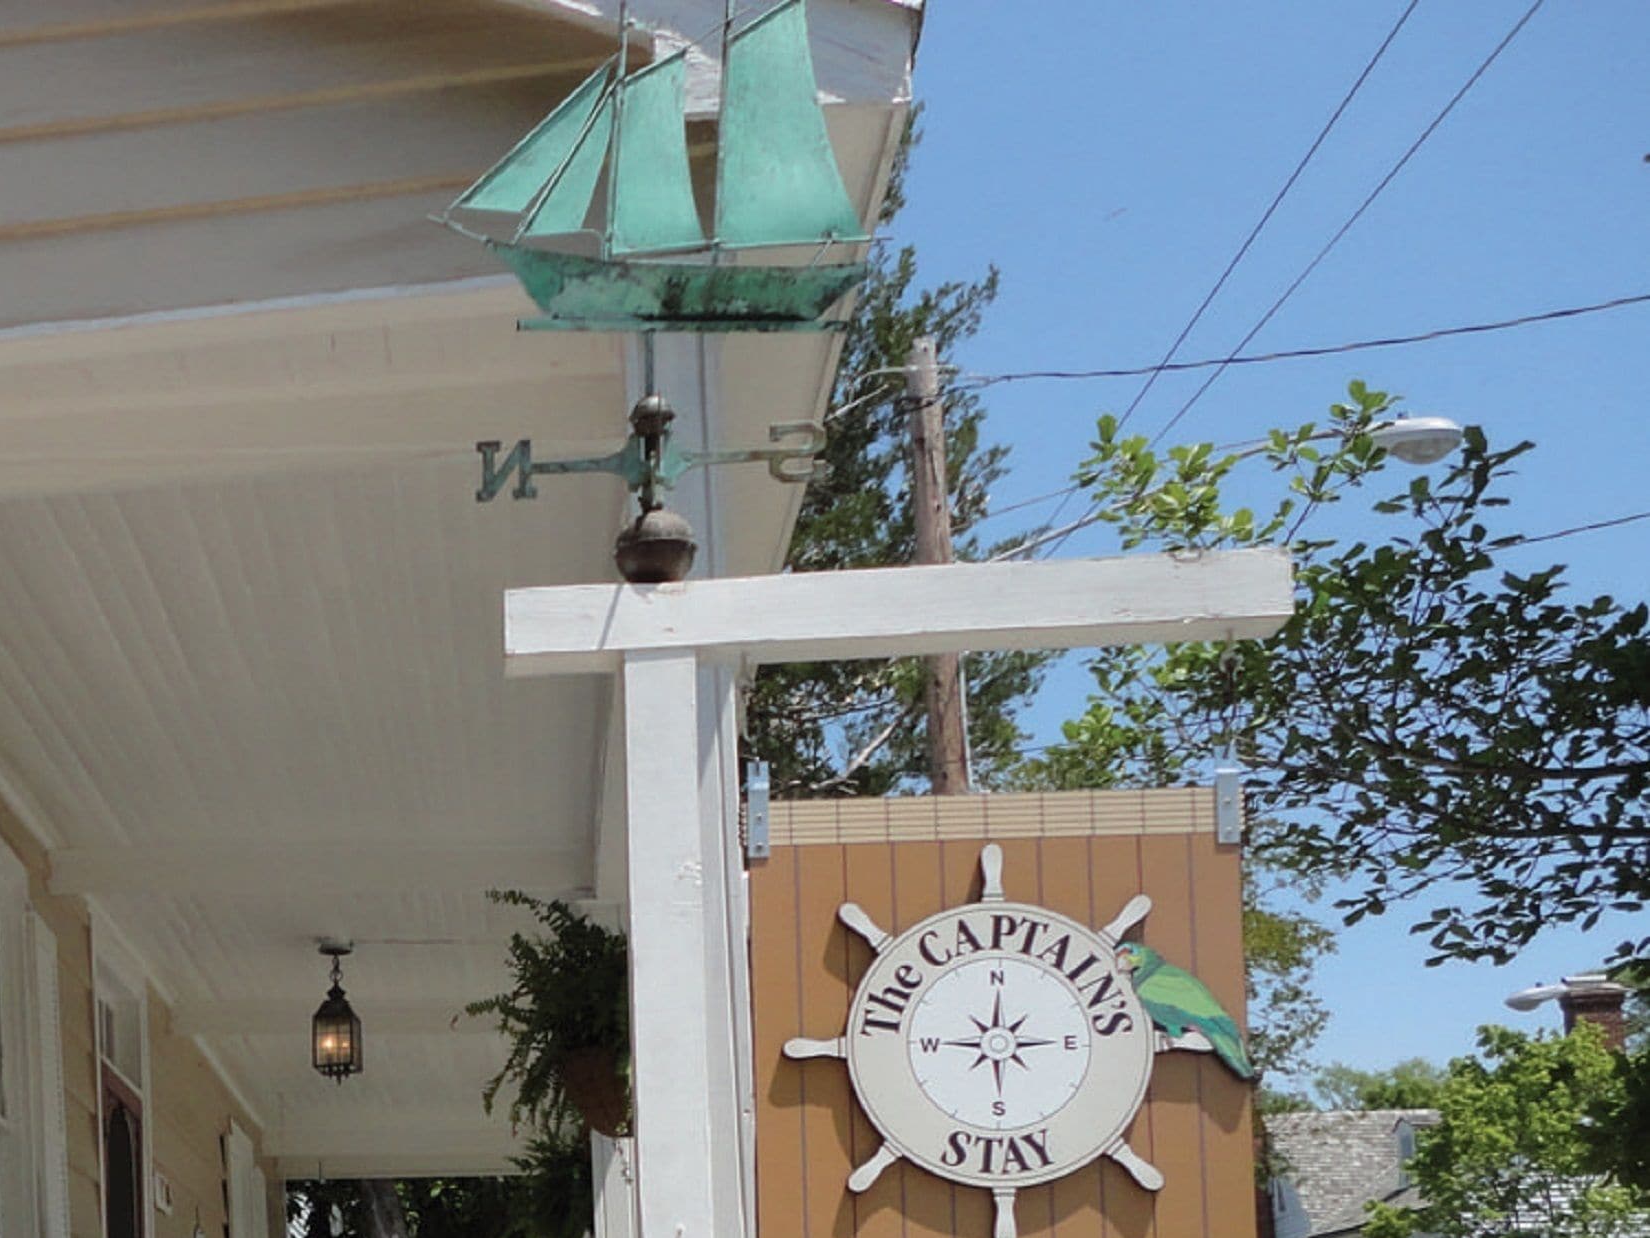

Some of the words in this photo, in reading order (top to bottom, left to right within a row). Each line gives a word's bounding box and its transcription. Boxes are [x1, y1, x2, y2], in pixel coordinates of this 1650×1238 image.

[860, 964, 923, 1037] The
[918, 914, 1133, 1036] CAPTAIN'S
[990, 970, 1005, 986] N
[920, 1037, 940, 1053] W
[1064, 1035, 1078, 1050] E
[991, 1101, 1006, 1116] S
[940, 1129, 1054, 1175] STAY
